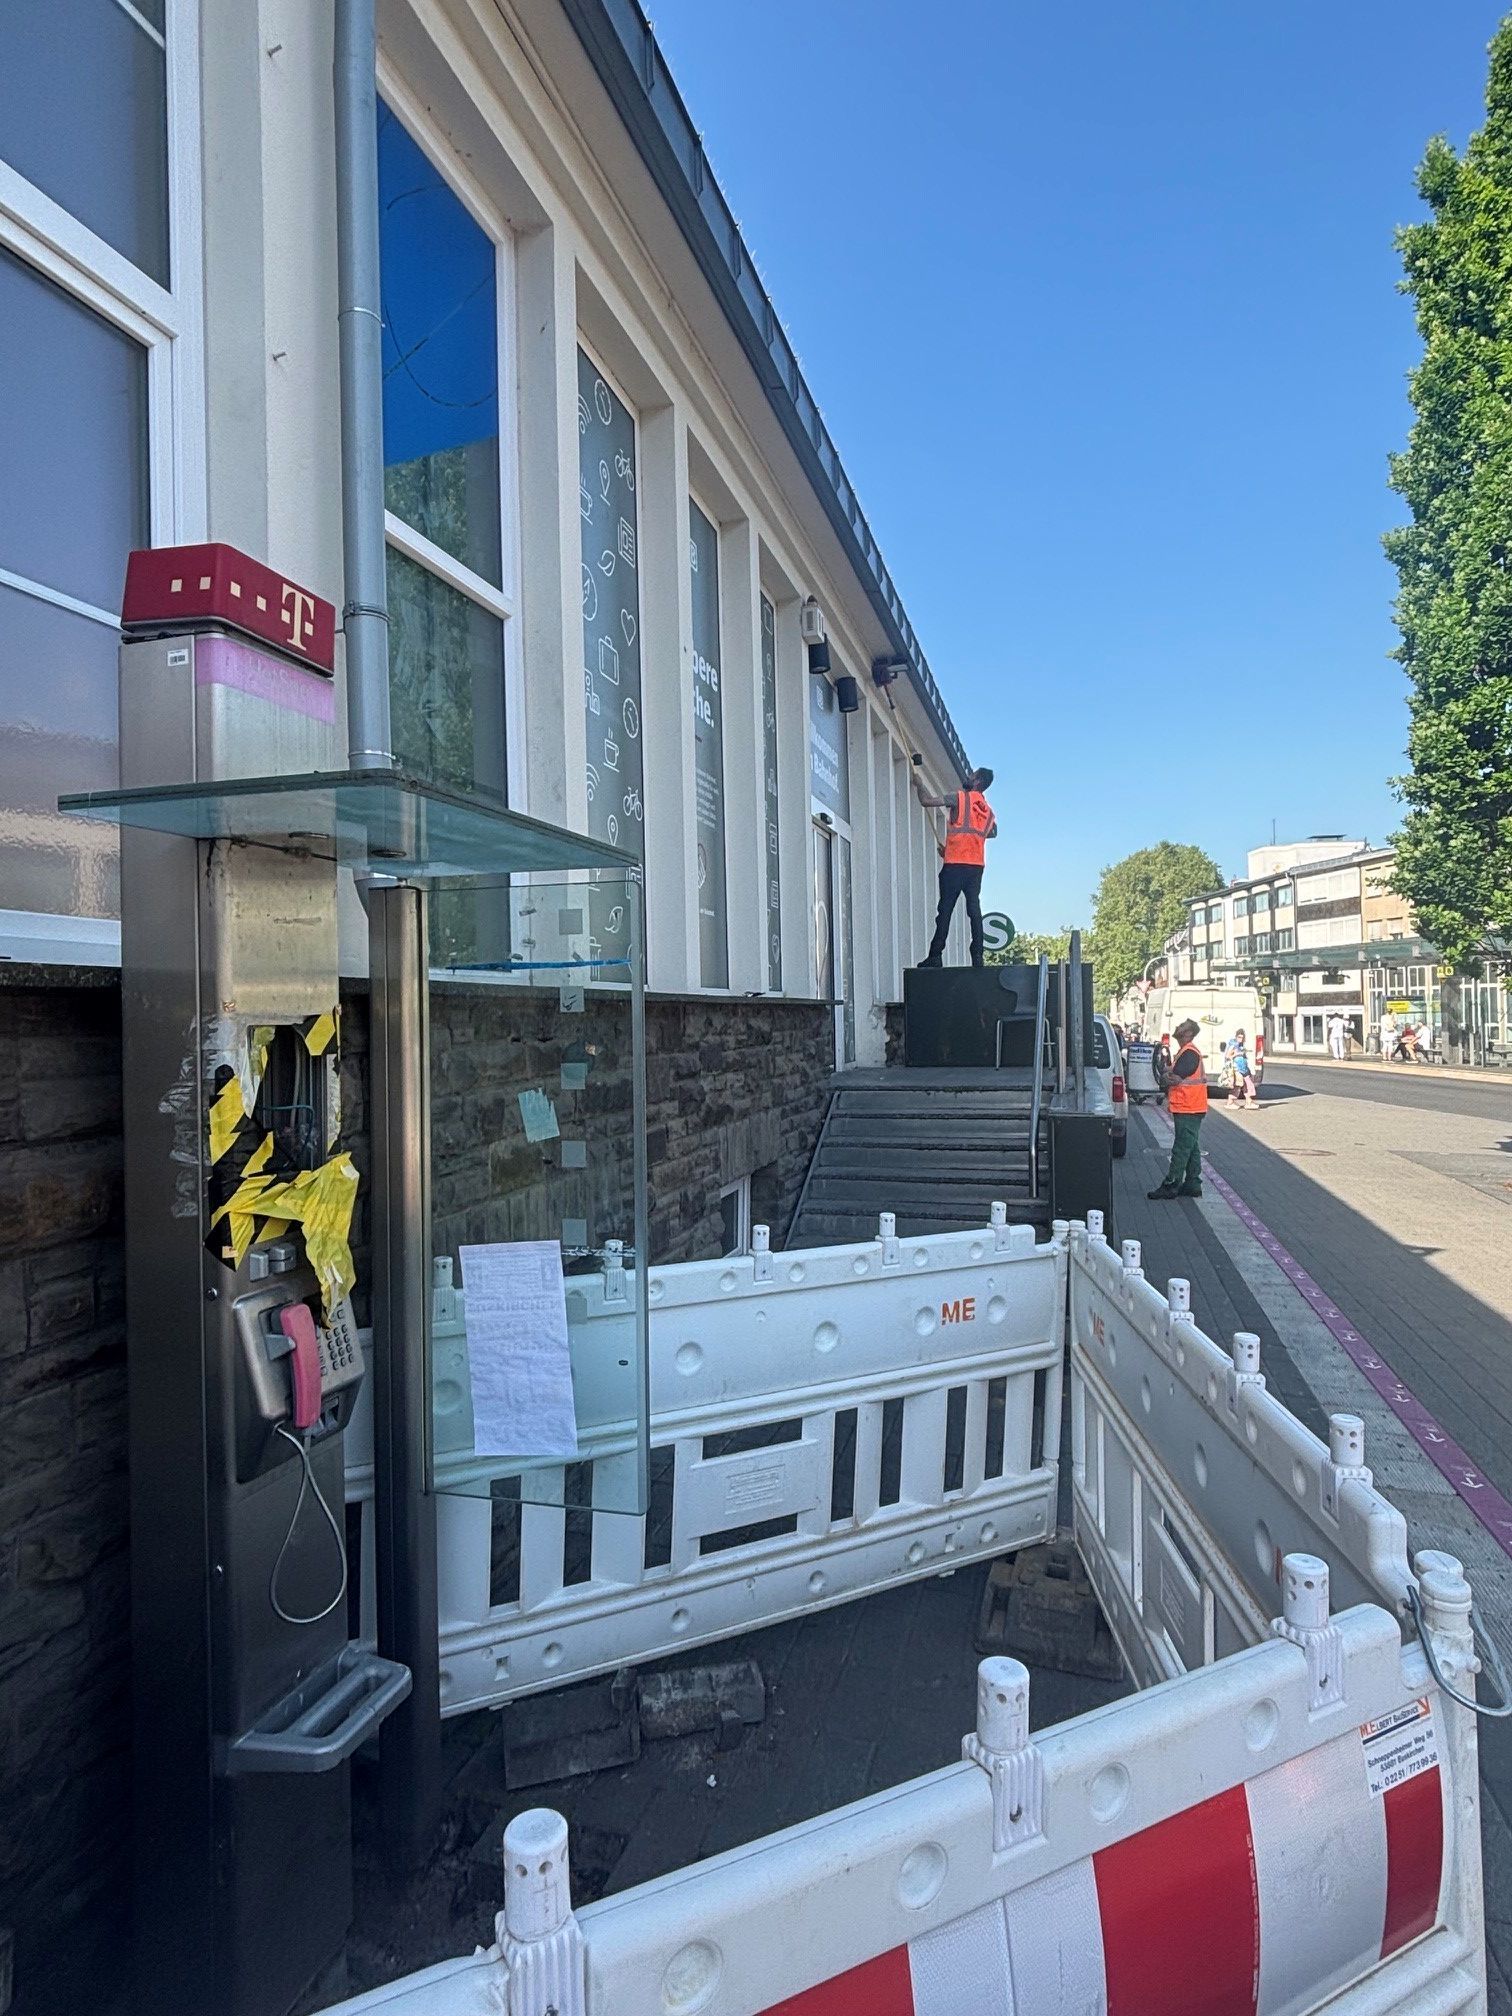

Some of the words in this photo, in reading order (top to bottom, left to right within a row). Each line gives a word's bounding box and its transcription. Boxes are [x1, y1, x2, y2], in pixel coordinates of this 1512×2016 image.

[282, 584, 314, 650] T
[982, 915, 1009, 950] S
[942, 1298, 976, 1325] ME
